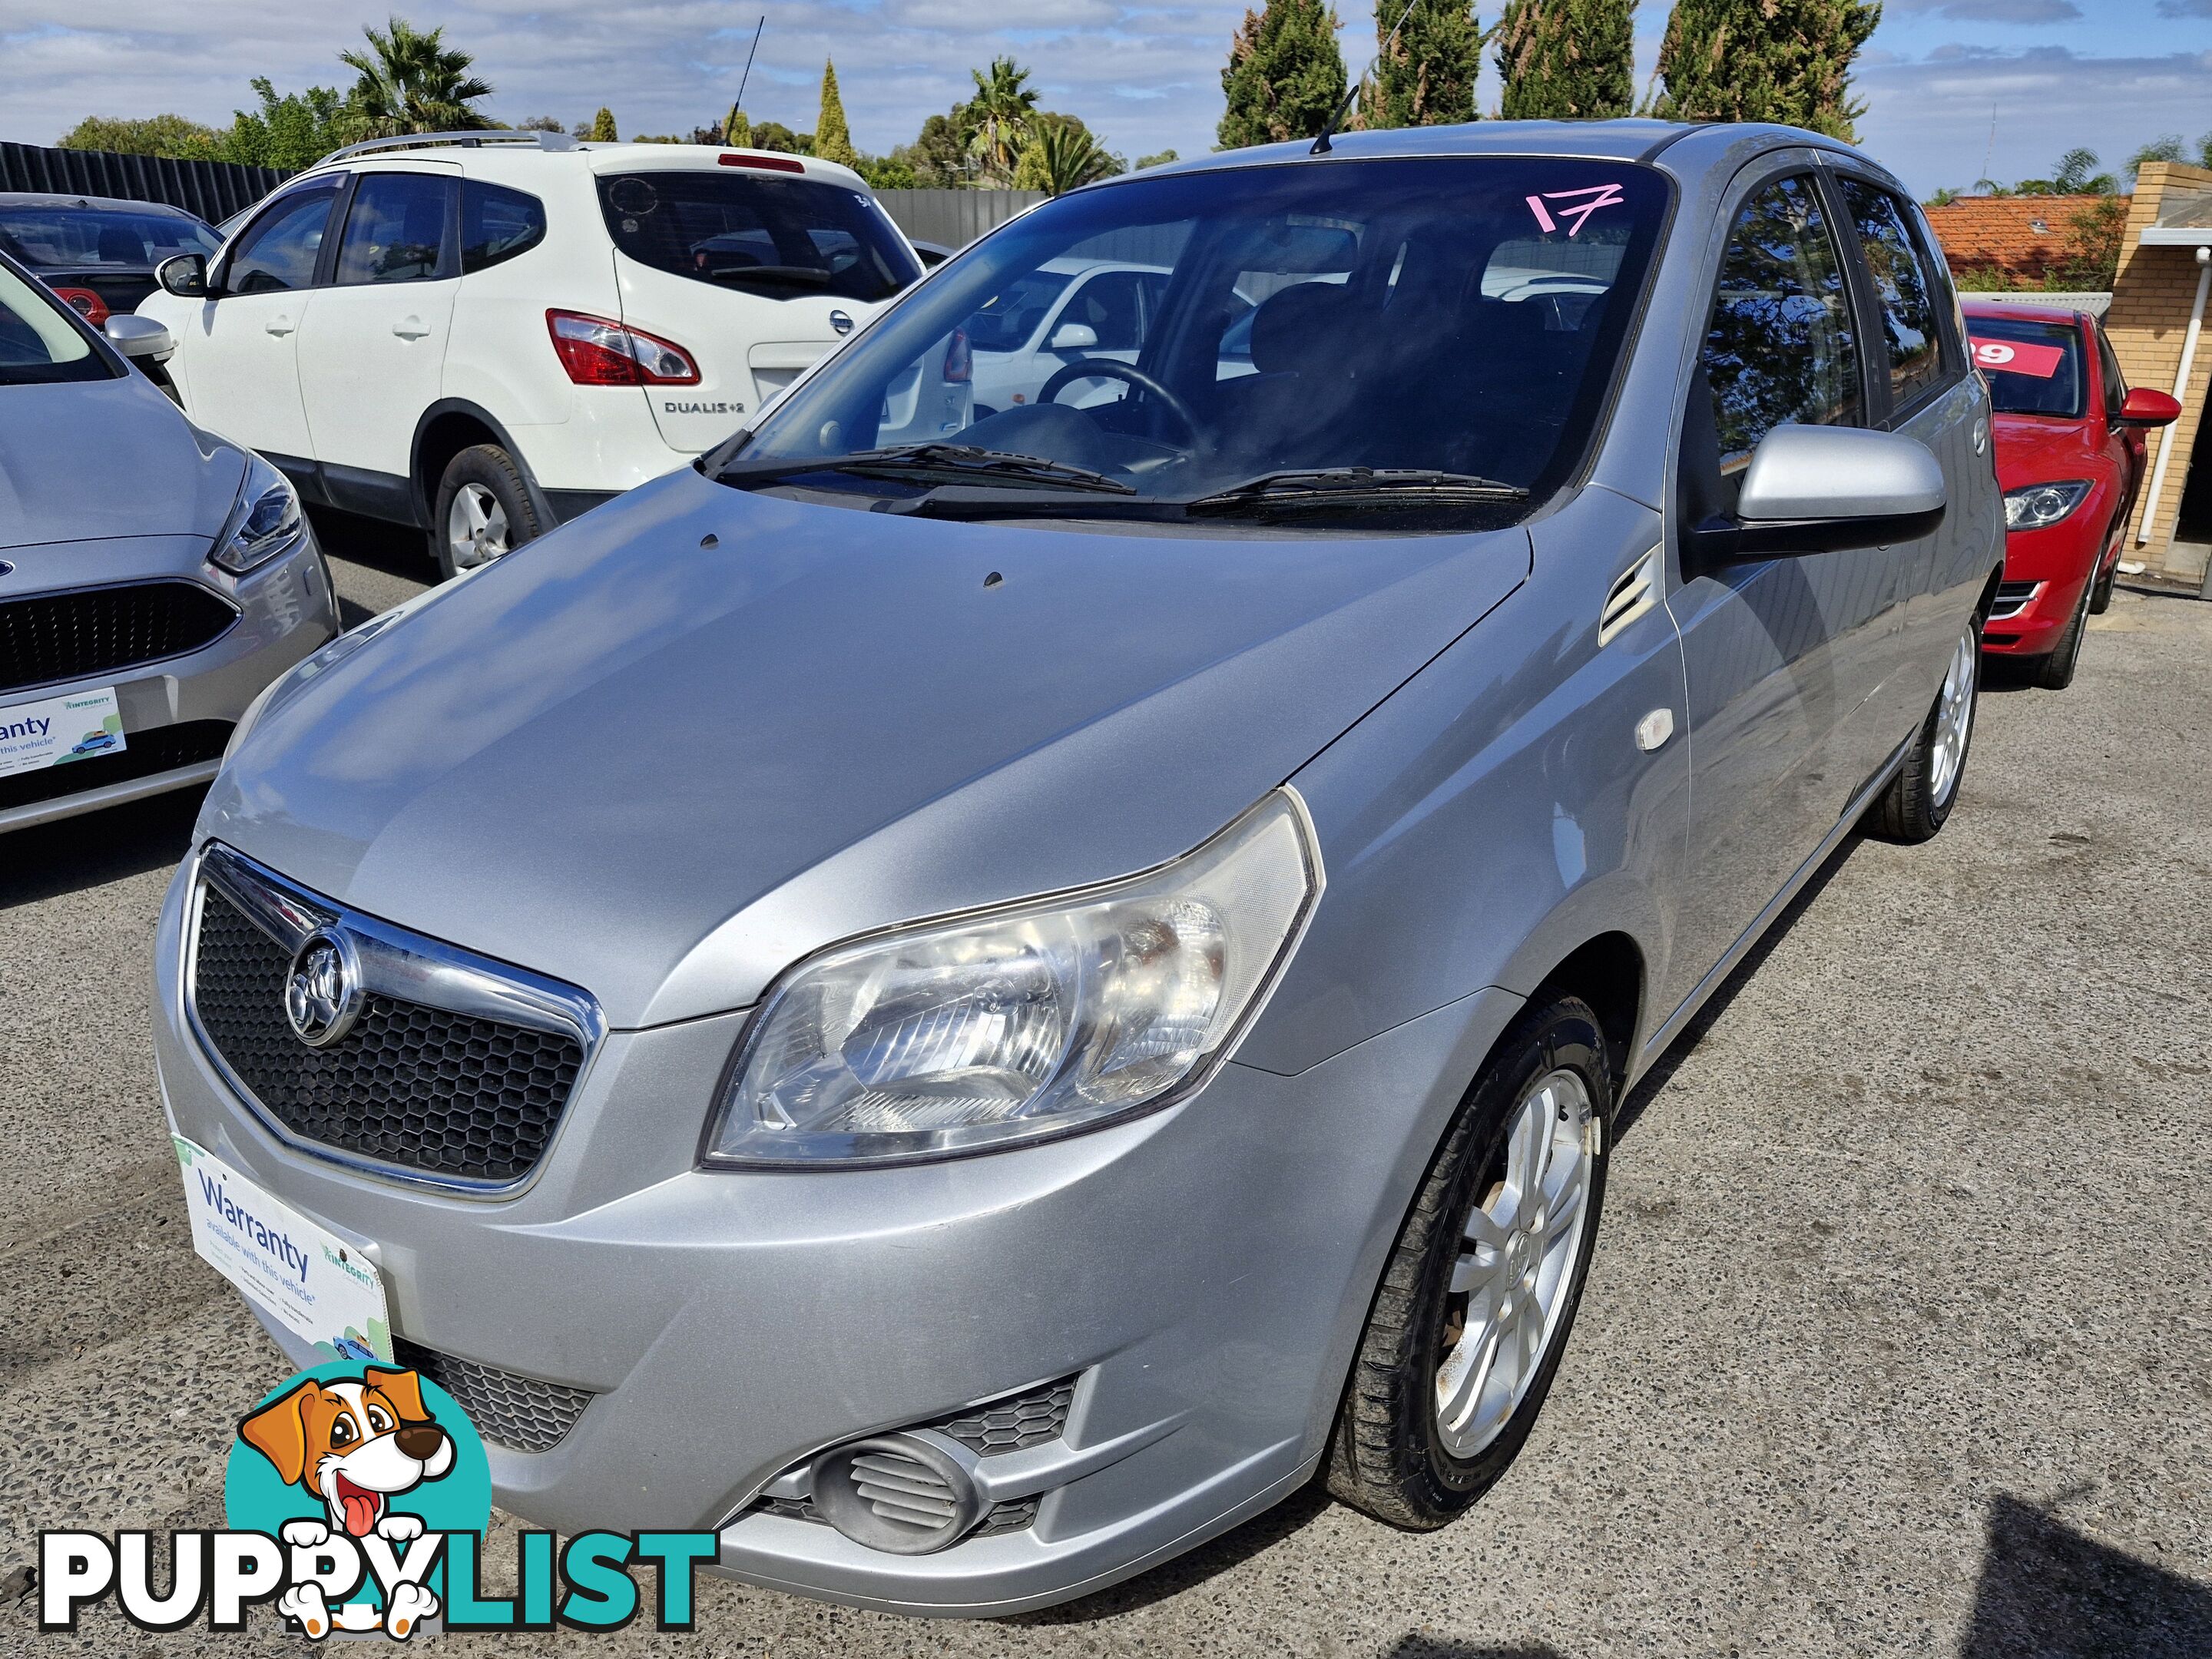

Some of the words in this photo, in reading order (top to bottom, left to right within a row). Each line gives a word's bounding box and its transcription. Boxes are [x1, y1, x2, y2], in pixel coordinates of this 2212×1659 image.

[1525, 184, 1624, 237] 17
[72, 697, 111, 709] INTEGRITY
[197, 1167, 309, 1283] Warranty
[206, 1218, 240, 1252] available
[242, 1246, 260, 1268] with
[262, 1260, 279, 1281] this
[331, 1254, 374, 1290] INTEGRITY
